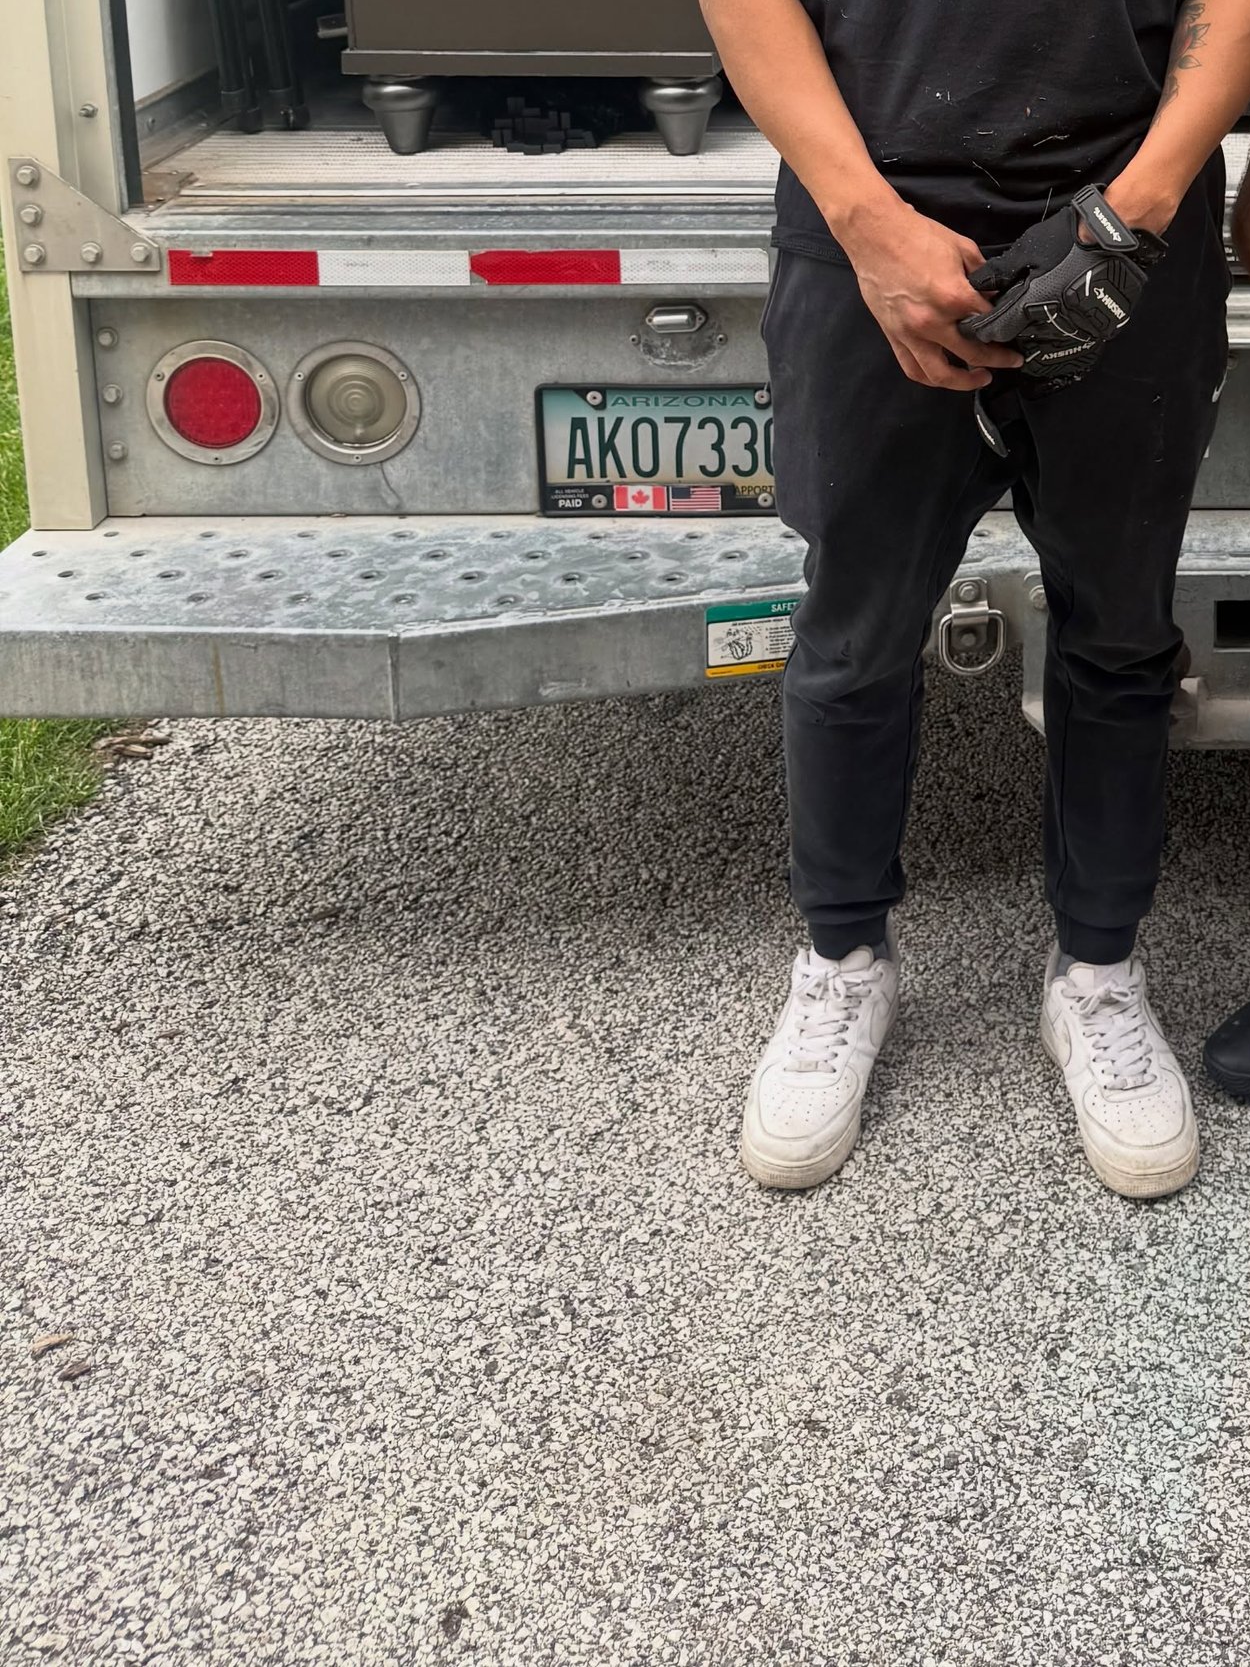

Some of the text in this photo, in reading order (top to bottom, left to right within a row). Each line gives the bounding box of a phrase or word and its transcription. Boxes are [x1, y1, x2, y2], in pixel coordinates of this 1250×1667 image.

[1041, 346, 1082, 361] HUSKY
[610, 395, 752, 408] ARIZONA
[734, 485, 774, 495] APPORT
[558, 498, 582, 508] PAID
